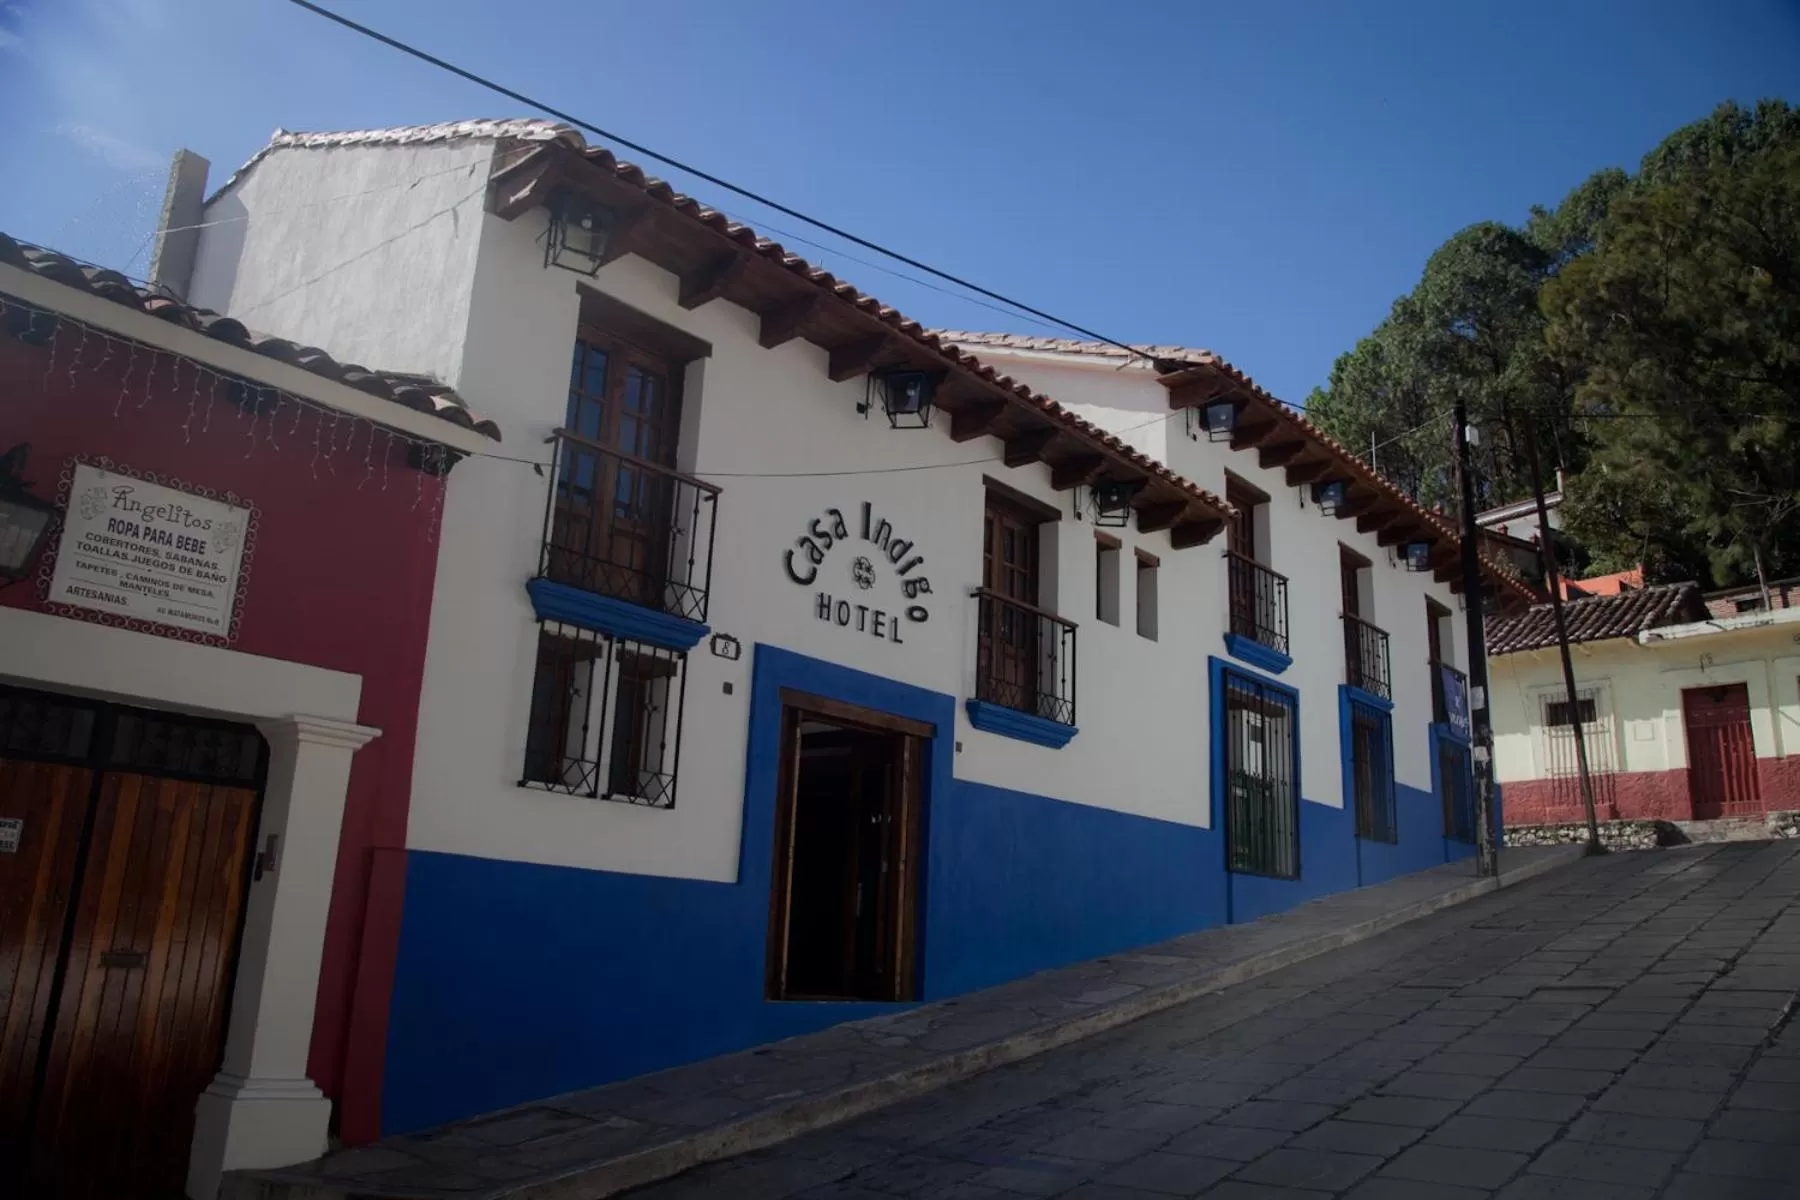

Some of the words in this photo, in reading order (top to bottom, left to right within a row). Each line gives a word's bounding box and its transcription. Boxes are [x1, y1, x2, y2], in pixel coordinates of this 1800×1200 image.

[112, 487, 213, 531] Angelitos
[107, 517, 139, 539] ROPA
[143, 526, 173, 547] PARA
[176, 534, 207, 555] BEBE
[179, 565, 193, 576] DE
[784, 508, 848, 586] Casa
[861, 501, 934, 623] Indigo
[65, 585, 128, 606] ARTESANIAS
[816, 592, 904, 644] HOTEL
